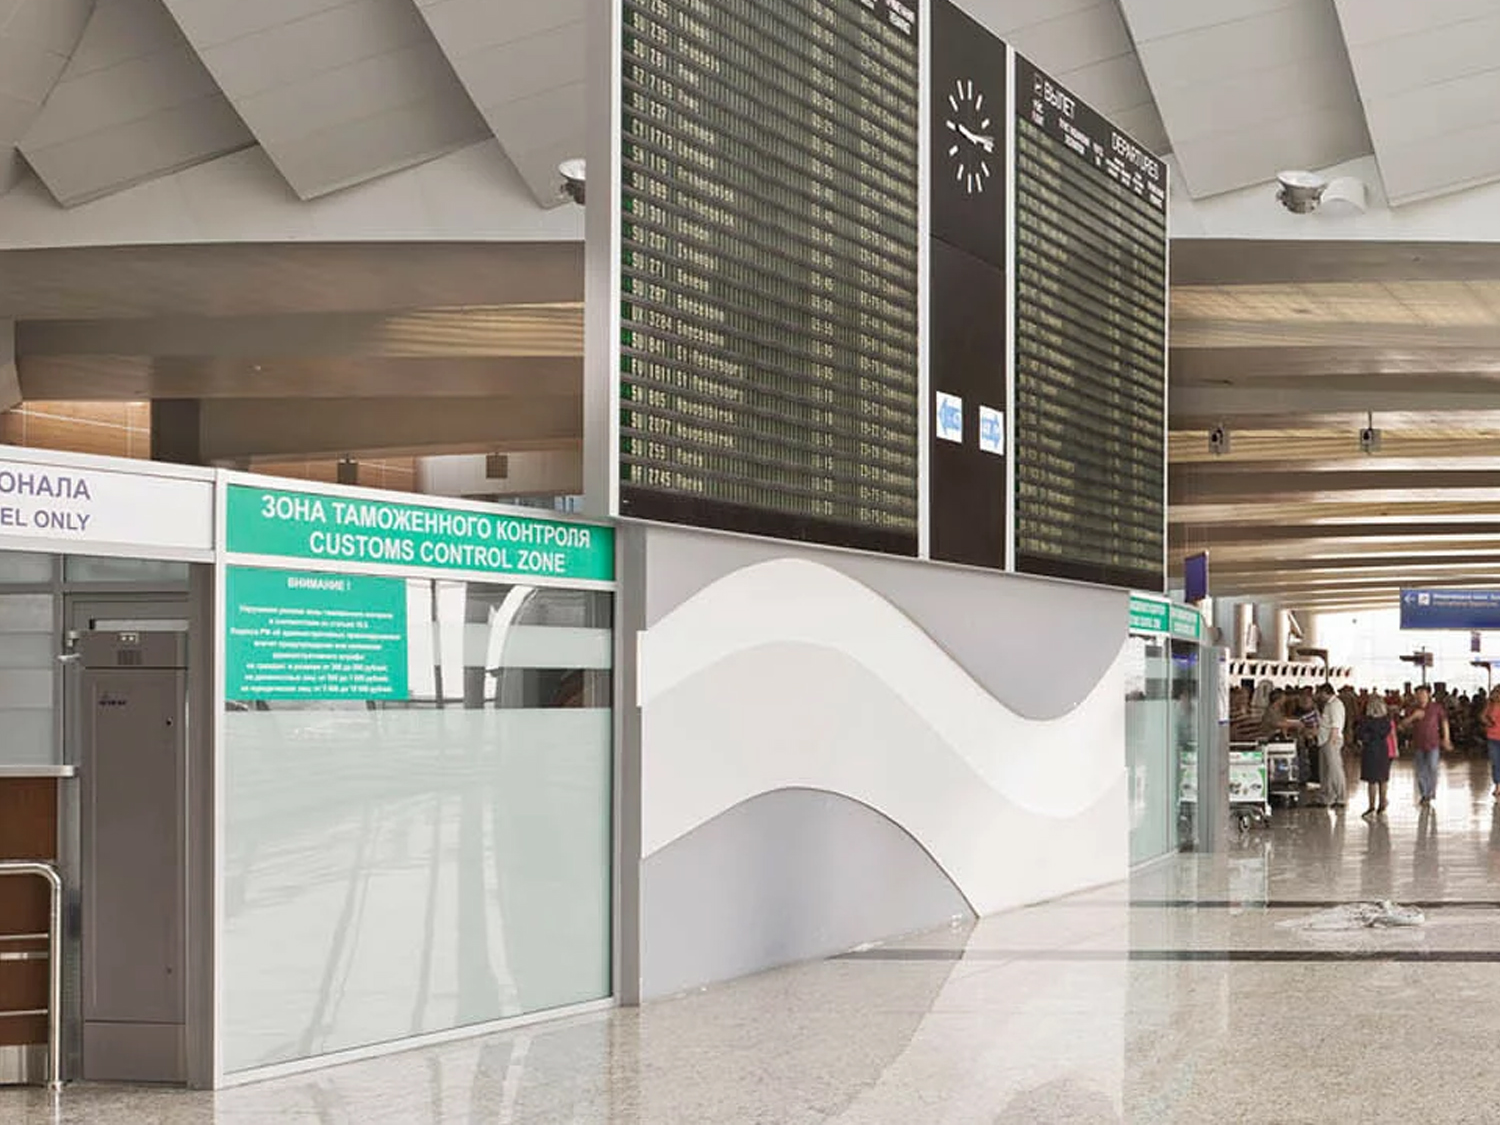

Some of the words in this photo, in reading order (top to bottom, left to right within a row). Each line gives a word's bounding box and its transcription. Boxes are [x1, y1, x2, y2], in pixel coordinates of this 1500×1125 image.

[0, 471, 91, 500] ОНАЛА
[0, 508, 28, 527] EL
[34, 510, 91, 531] ONLY
[261, 495, 326, 523] ЗОНА
[332, 502, 492, 539] ТАМОЖЕННОГО
[496, 520, 591, 549] КОНТРОЛЯ
[310, 531, 414, 561] CUSTOMS
[420, 541, 512, 569] CONTROL
[517, 550, 566, 573] ZONE
